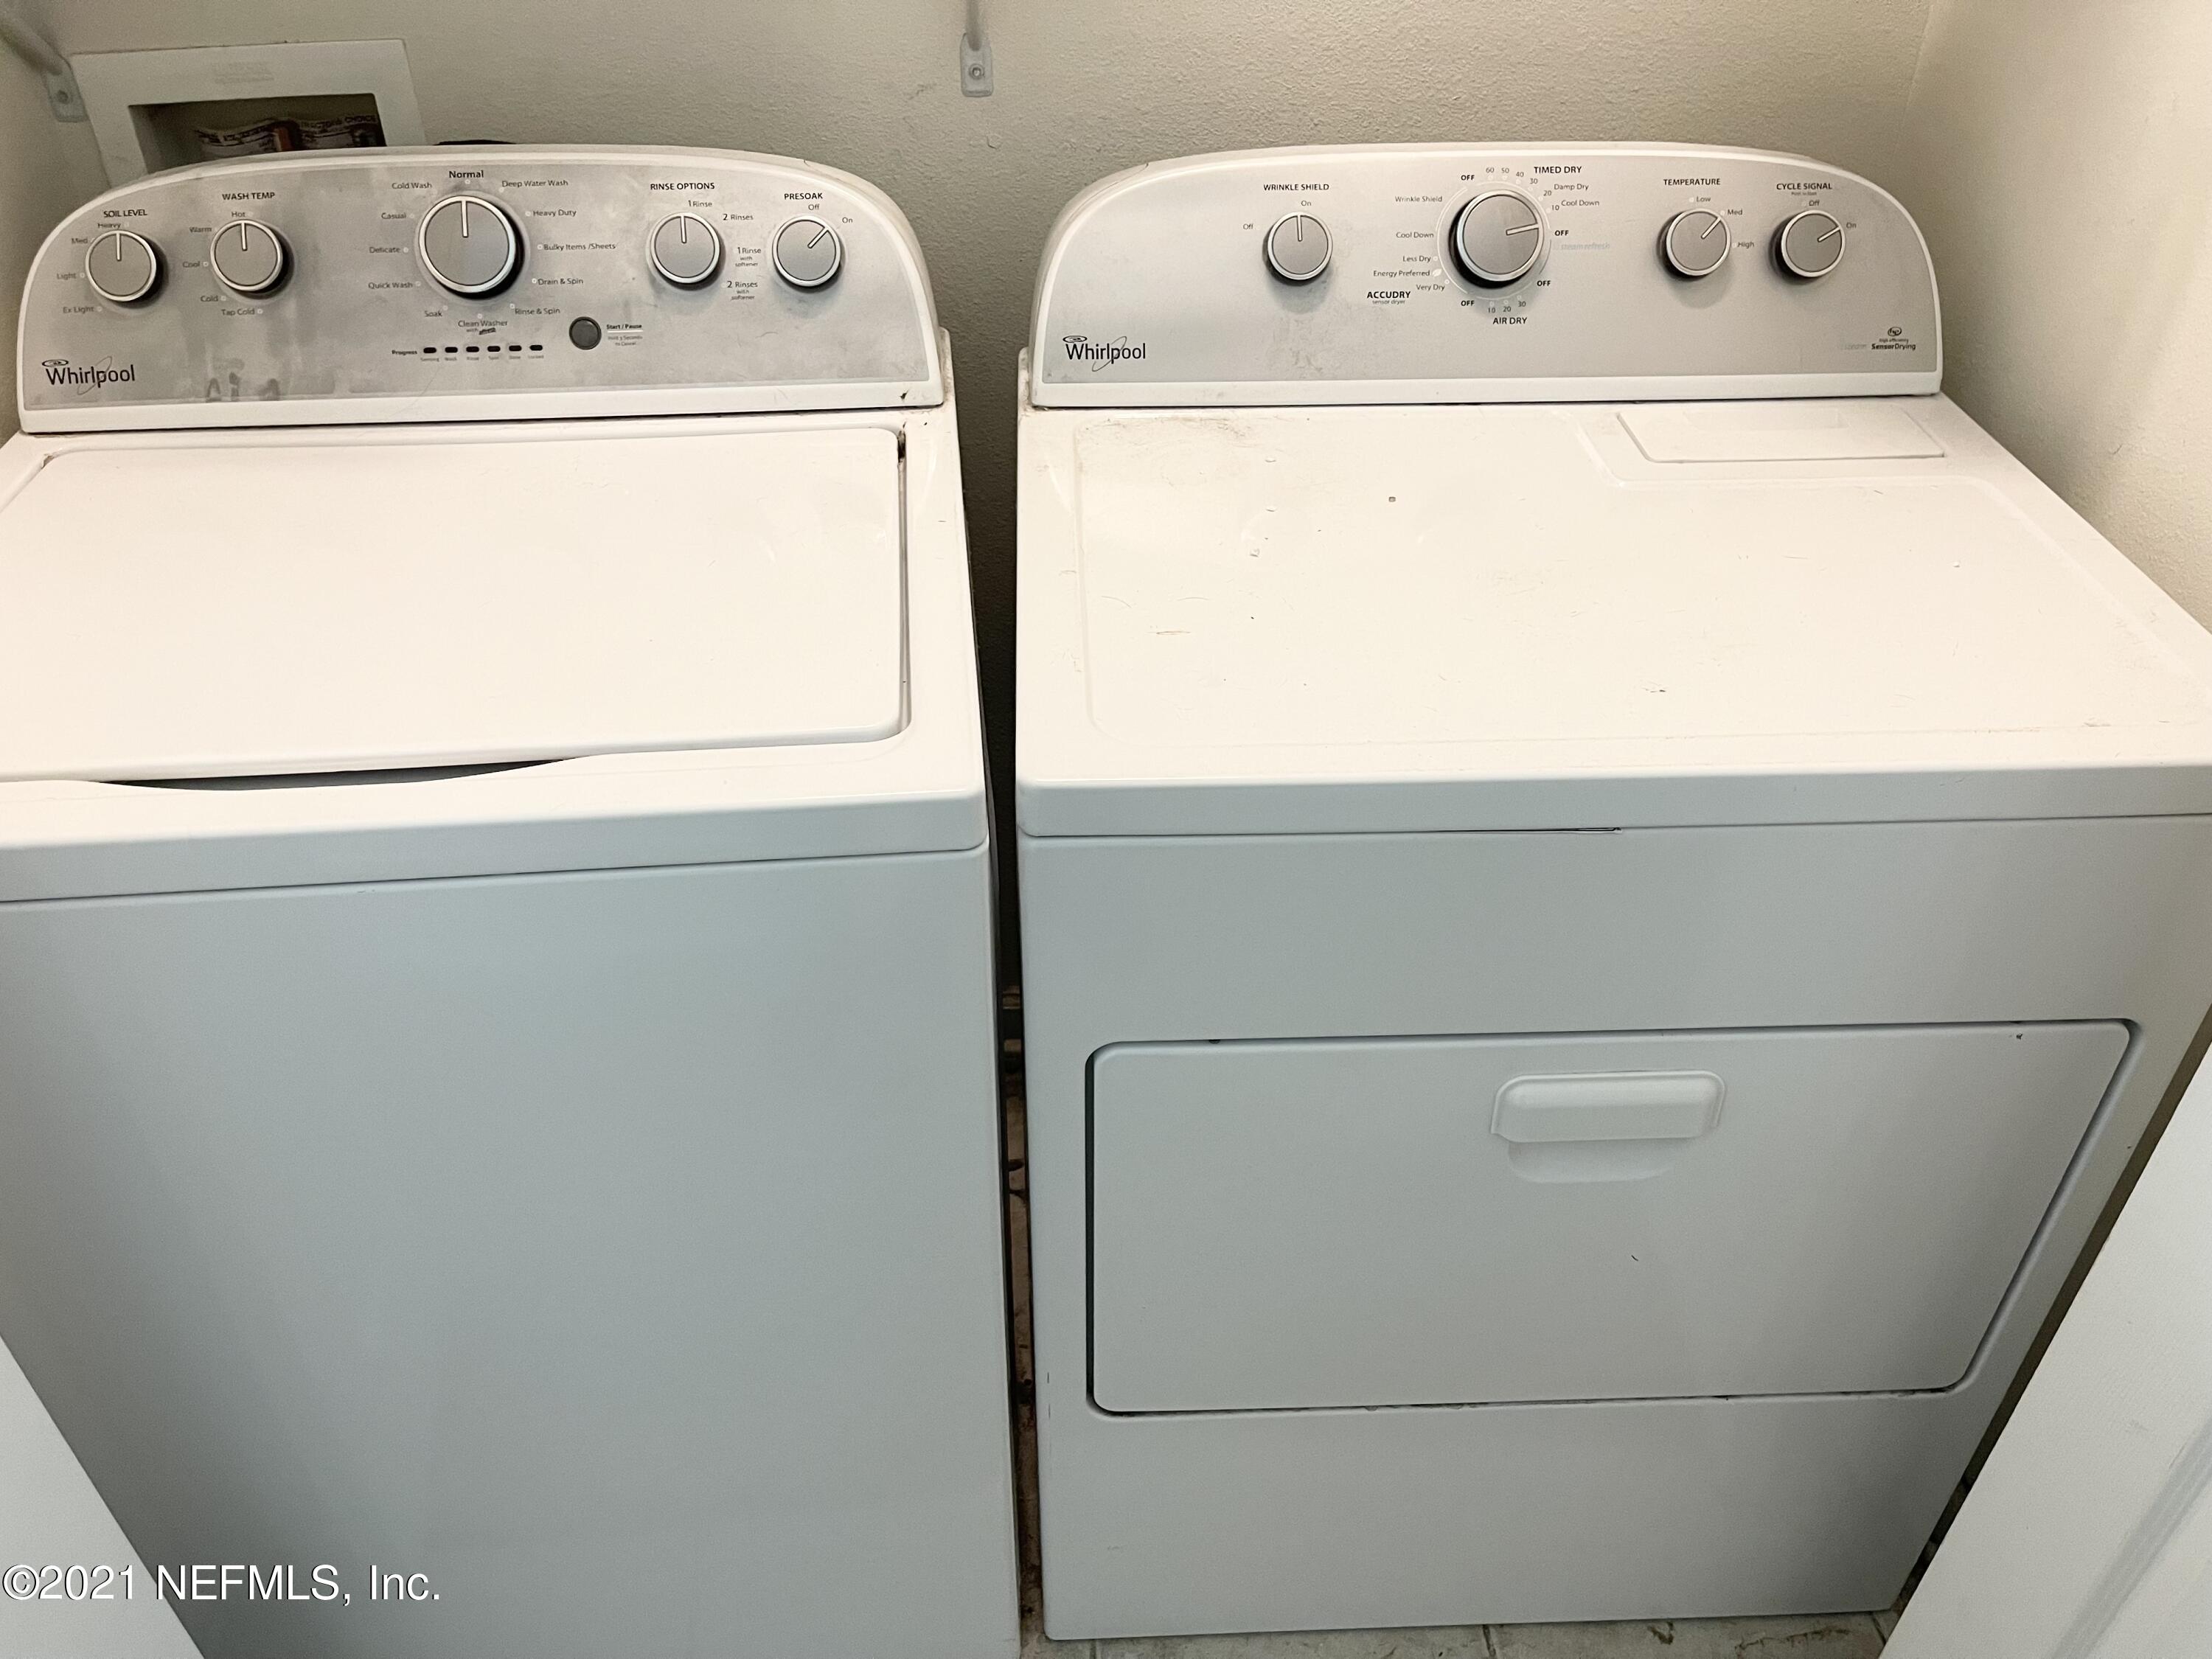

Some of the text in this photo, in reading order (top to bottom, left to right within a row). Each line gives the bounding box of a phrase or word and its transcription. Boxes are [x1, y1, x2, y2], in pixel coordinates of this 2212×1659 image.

[1534, 166, 1582, 174] TIMED DRY
[448, 170, 484, 179] Normal
[501, 178, 568, 189] Deep Water Wash
[1663, 178, 1721, 186] TEMPERATURE
[1804, 182, 1832, 190] SIGNAL
[650, 182, 715, 191] RINSE OPTIONS
[1263, 183, 1329, 191] WRINKLE SHIELD
[1554, 183, 1589, 192] Damp Dry
[222, 191, 276, 201] WASH TEMP
[784, 192, 823, 201] PRESOAK
[1421, 195, 1443, 203] Shield
[1561, 199, 1577, 207] Cool
[103, 209, 147, 218] SOIL LEVEL
[381, 212, 406, 220] Casual
[533, 209, 577, 218] Heavy Duty
[97, 222, 122, 231] Heavy
[189, 226, 212, 234] Warm
[1242, 223, 1254, 231] Off
[1413, 231, 1434, 239] Down
[71, 237, 88, 245] Med
[1738, 240, 1755, 249] High
[369, 246, 401, 254] Delicate
[543, 243, 564, 251] Bulky
[566, 243, 586, 251] Items
[737, 246, 742, 254] 1
[1419, 255, 1431, 263] Dry
[56, 271, 77, 281] Light
[1373, 270, 1397, 278] Energy
[368, 280, 413, 290] Quick Wash
[538, 277, 559, 285] Drain
[567, 277, 584, 286] Spin
[727, 280, 758, 288] 2 Rinses
[1433, 283, 1445, 292] Dry
[1366, 291, 1411, 299] ACCUDRY
[63, 305, 94, 315] Ex Light
[221, 309, 236, 318] Tap
[425, 310, 442, 318] Soak
[515, 307, 535, 316] Rinse
[543, 307, 561, 316] Spin
[458, 319, 508, 327] Clean Washer
[1492, 317, 1528, 325] AIR DRY
[1871, 343, 1916, 351] SensorDrying
[1065, 342, 1146, 365] Whirlpool
[45, 364, 136, 388] Whirlpool
